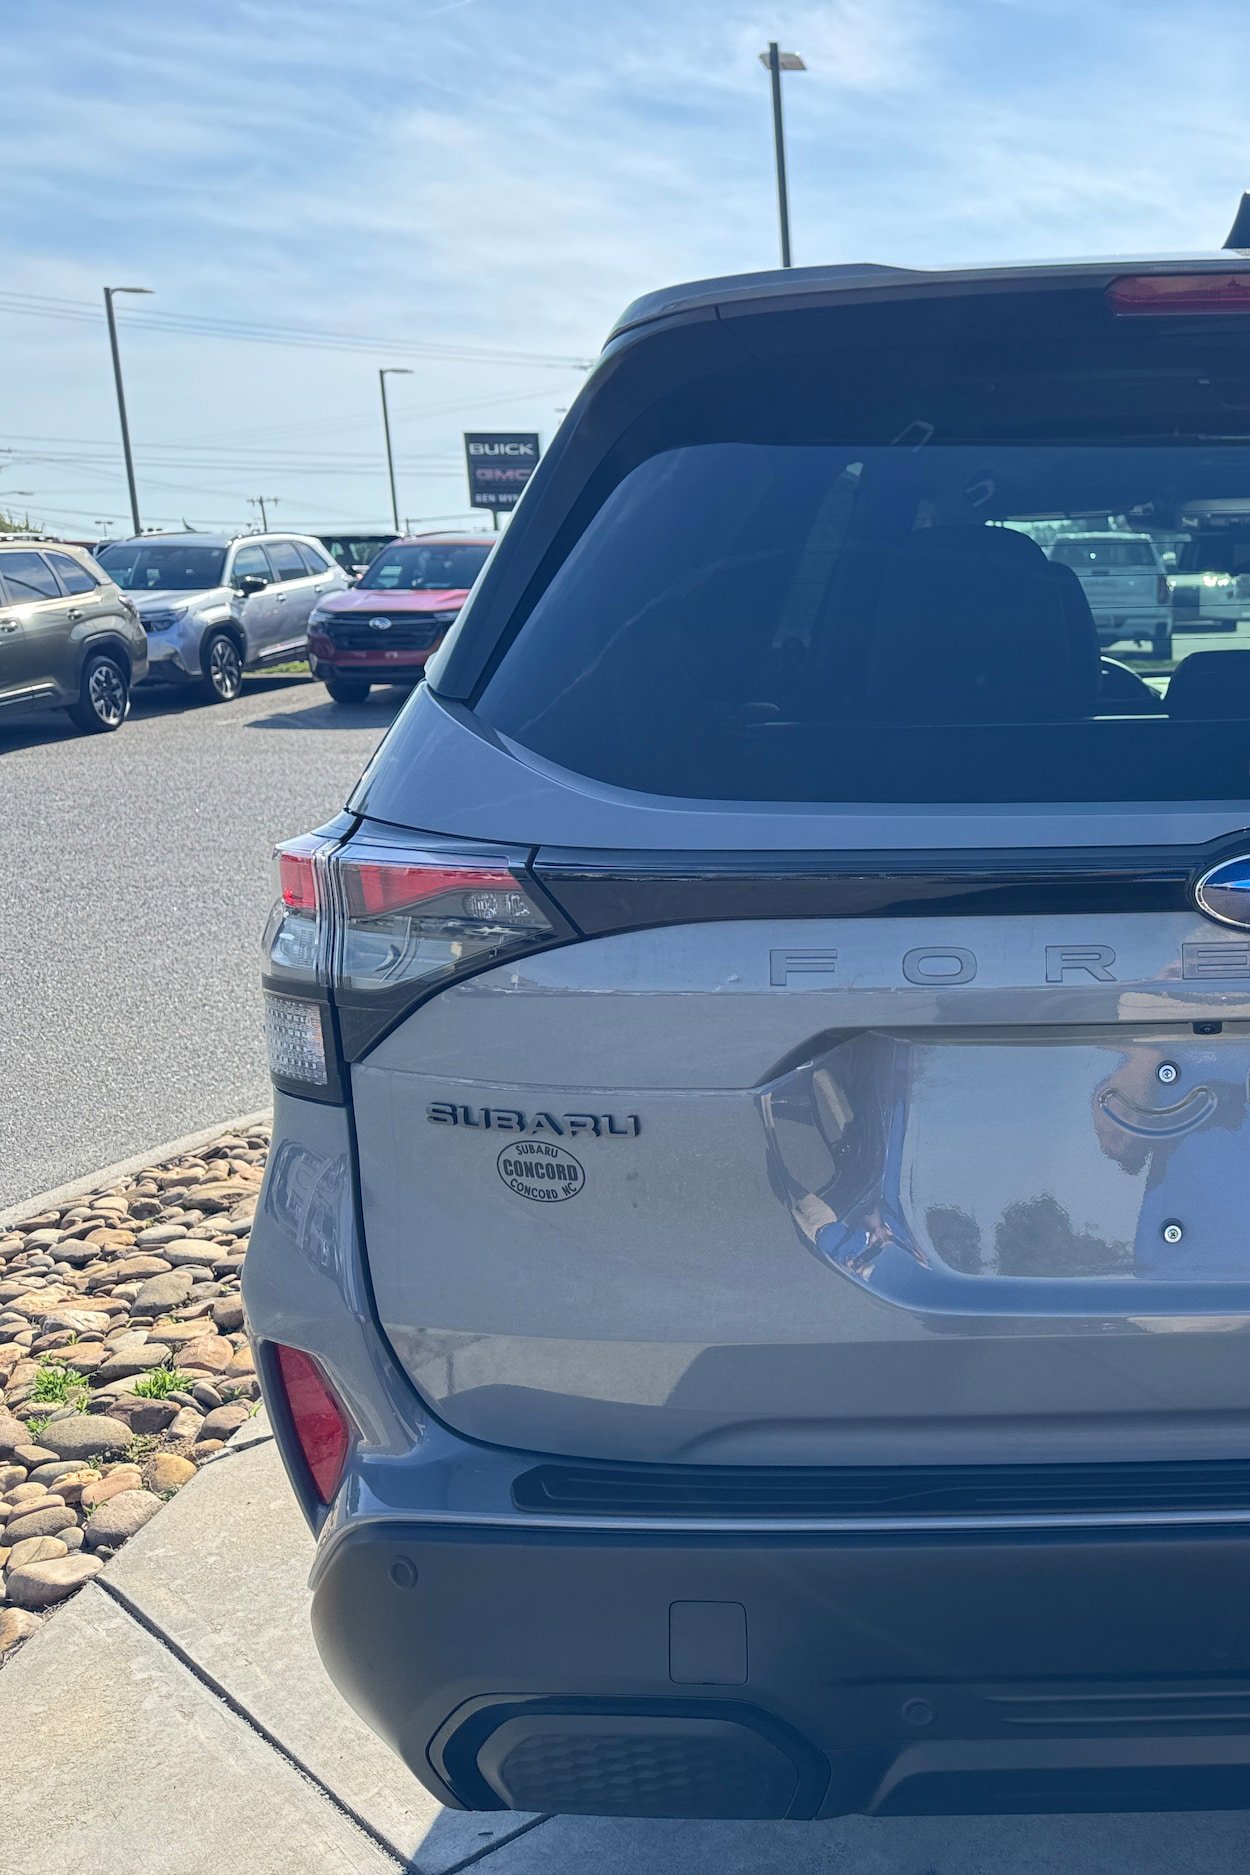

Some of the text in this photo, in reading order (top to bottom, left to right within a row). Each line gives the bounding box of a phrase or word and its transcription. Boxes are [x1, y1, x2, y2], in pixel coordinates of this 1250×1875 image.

[469, 442, 535, 456] BUICK
[475, 468, 532, 481] GMC
[426, 1101, 641, 1138] SUBARU
[515, 1143, 559, 1159] SUBARU
[502, 1158, 579, 1182] CONCORD
[509, 1177, 577, 1200] CONCORD NC
